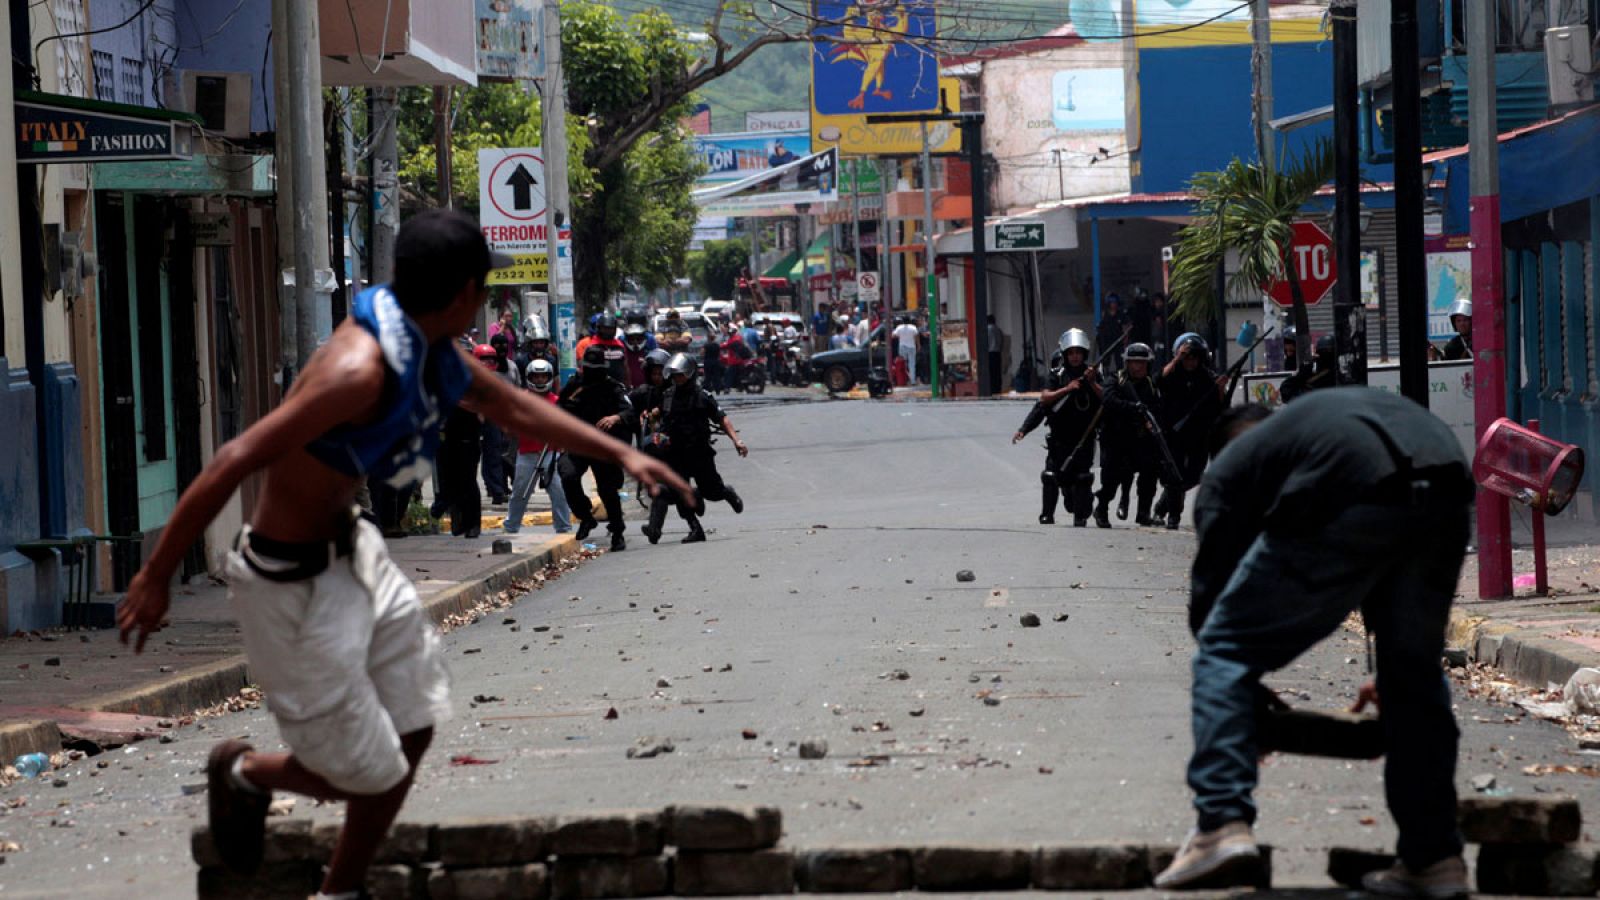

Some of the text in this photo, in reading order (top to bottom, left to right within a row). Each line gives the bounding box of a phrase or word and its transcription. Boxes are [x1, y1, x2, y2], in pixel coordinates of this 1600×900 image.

[20, 121, 167, 151] ITALY FASHION
[516, 257, 548, 266] SAYA
[1294, 243, 1330, 281] TO
[495, 271, 525, 280] 2522
